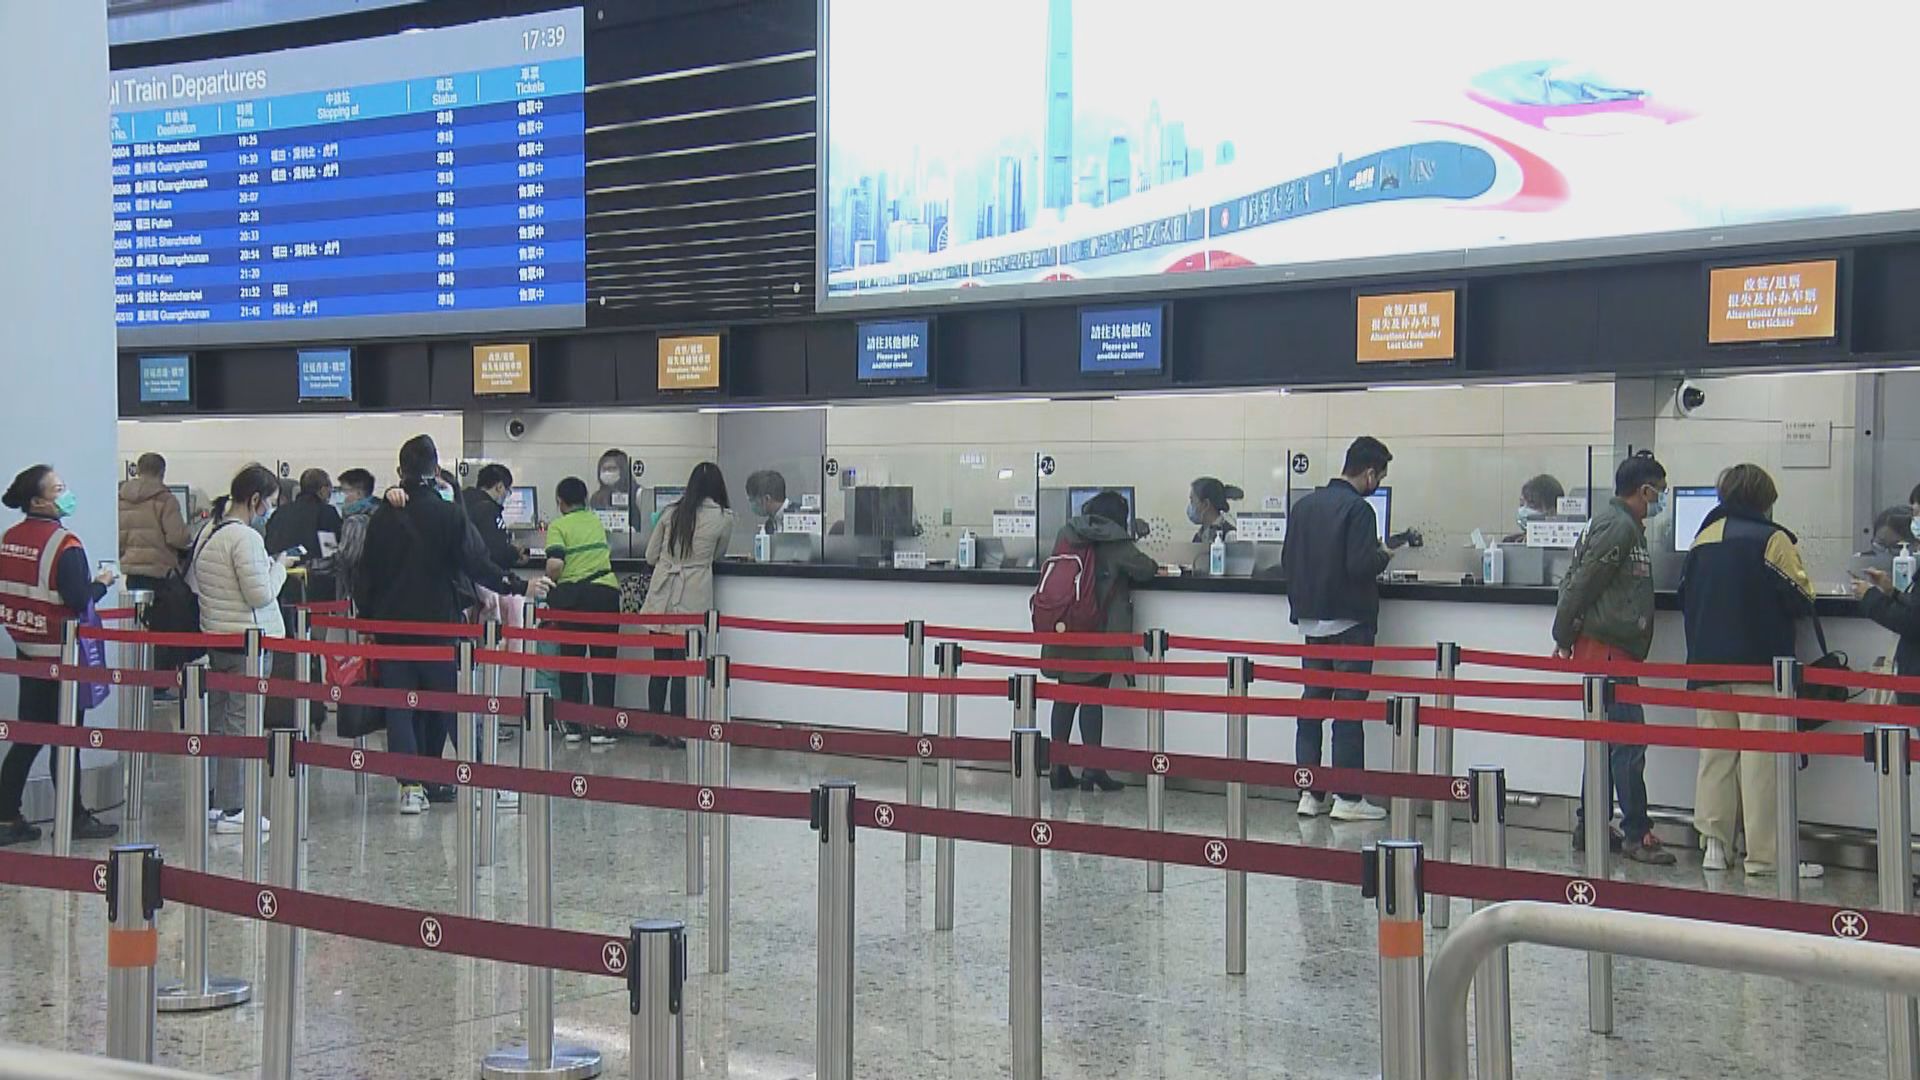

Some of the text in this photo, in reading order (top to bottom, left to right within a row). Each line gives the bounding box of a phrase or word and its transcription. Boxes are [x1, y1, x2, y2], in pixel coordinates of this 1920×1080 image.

[523, 26, 565, 51] 17:39
[124, 76, 167, 103] Train
[172, 69, 267, 102] Departures
[516, 81, 545, 95] Tickets
[432, 92, 457, 105] Status
[317, 105, 350, 120] Stopping
[236, 116, 255, 130] Time
[238, 134, 258, 147] 19:25
[239, 153, 258, 166] 19:30
[238, 172, 258, 185] 20:02
[239, 191, 259, 204] 20:07
[239, 210, 259, 223] 20:28
[239, 229, 259, 242] 20:33
[240, 249, 260, 261] 20:54
[240, 268, 260, 280] 21:20
[240, 286, 260, 298] 21:32
[240, 306, 260, 318] 21:45
[1747, 317, 1794, 329] Lost tickets
[1102, 341, 1138, 351] Please go to
[1387, 340, 1424, 350] Lost tickets
[876, 351, 907, 361] Please go to
[1096, 351, 1144, 360] another counter
[871, 360, 913, 369] another counter
[1042, 460, 1054, 472] 24
[1294, 457, 1308, 471] 25
